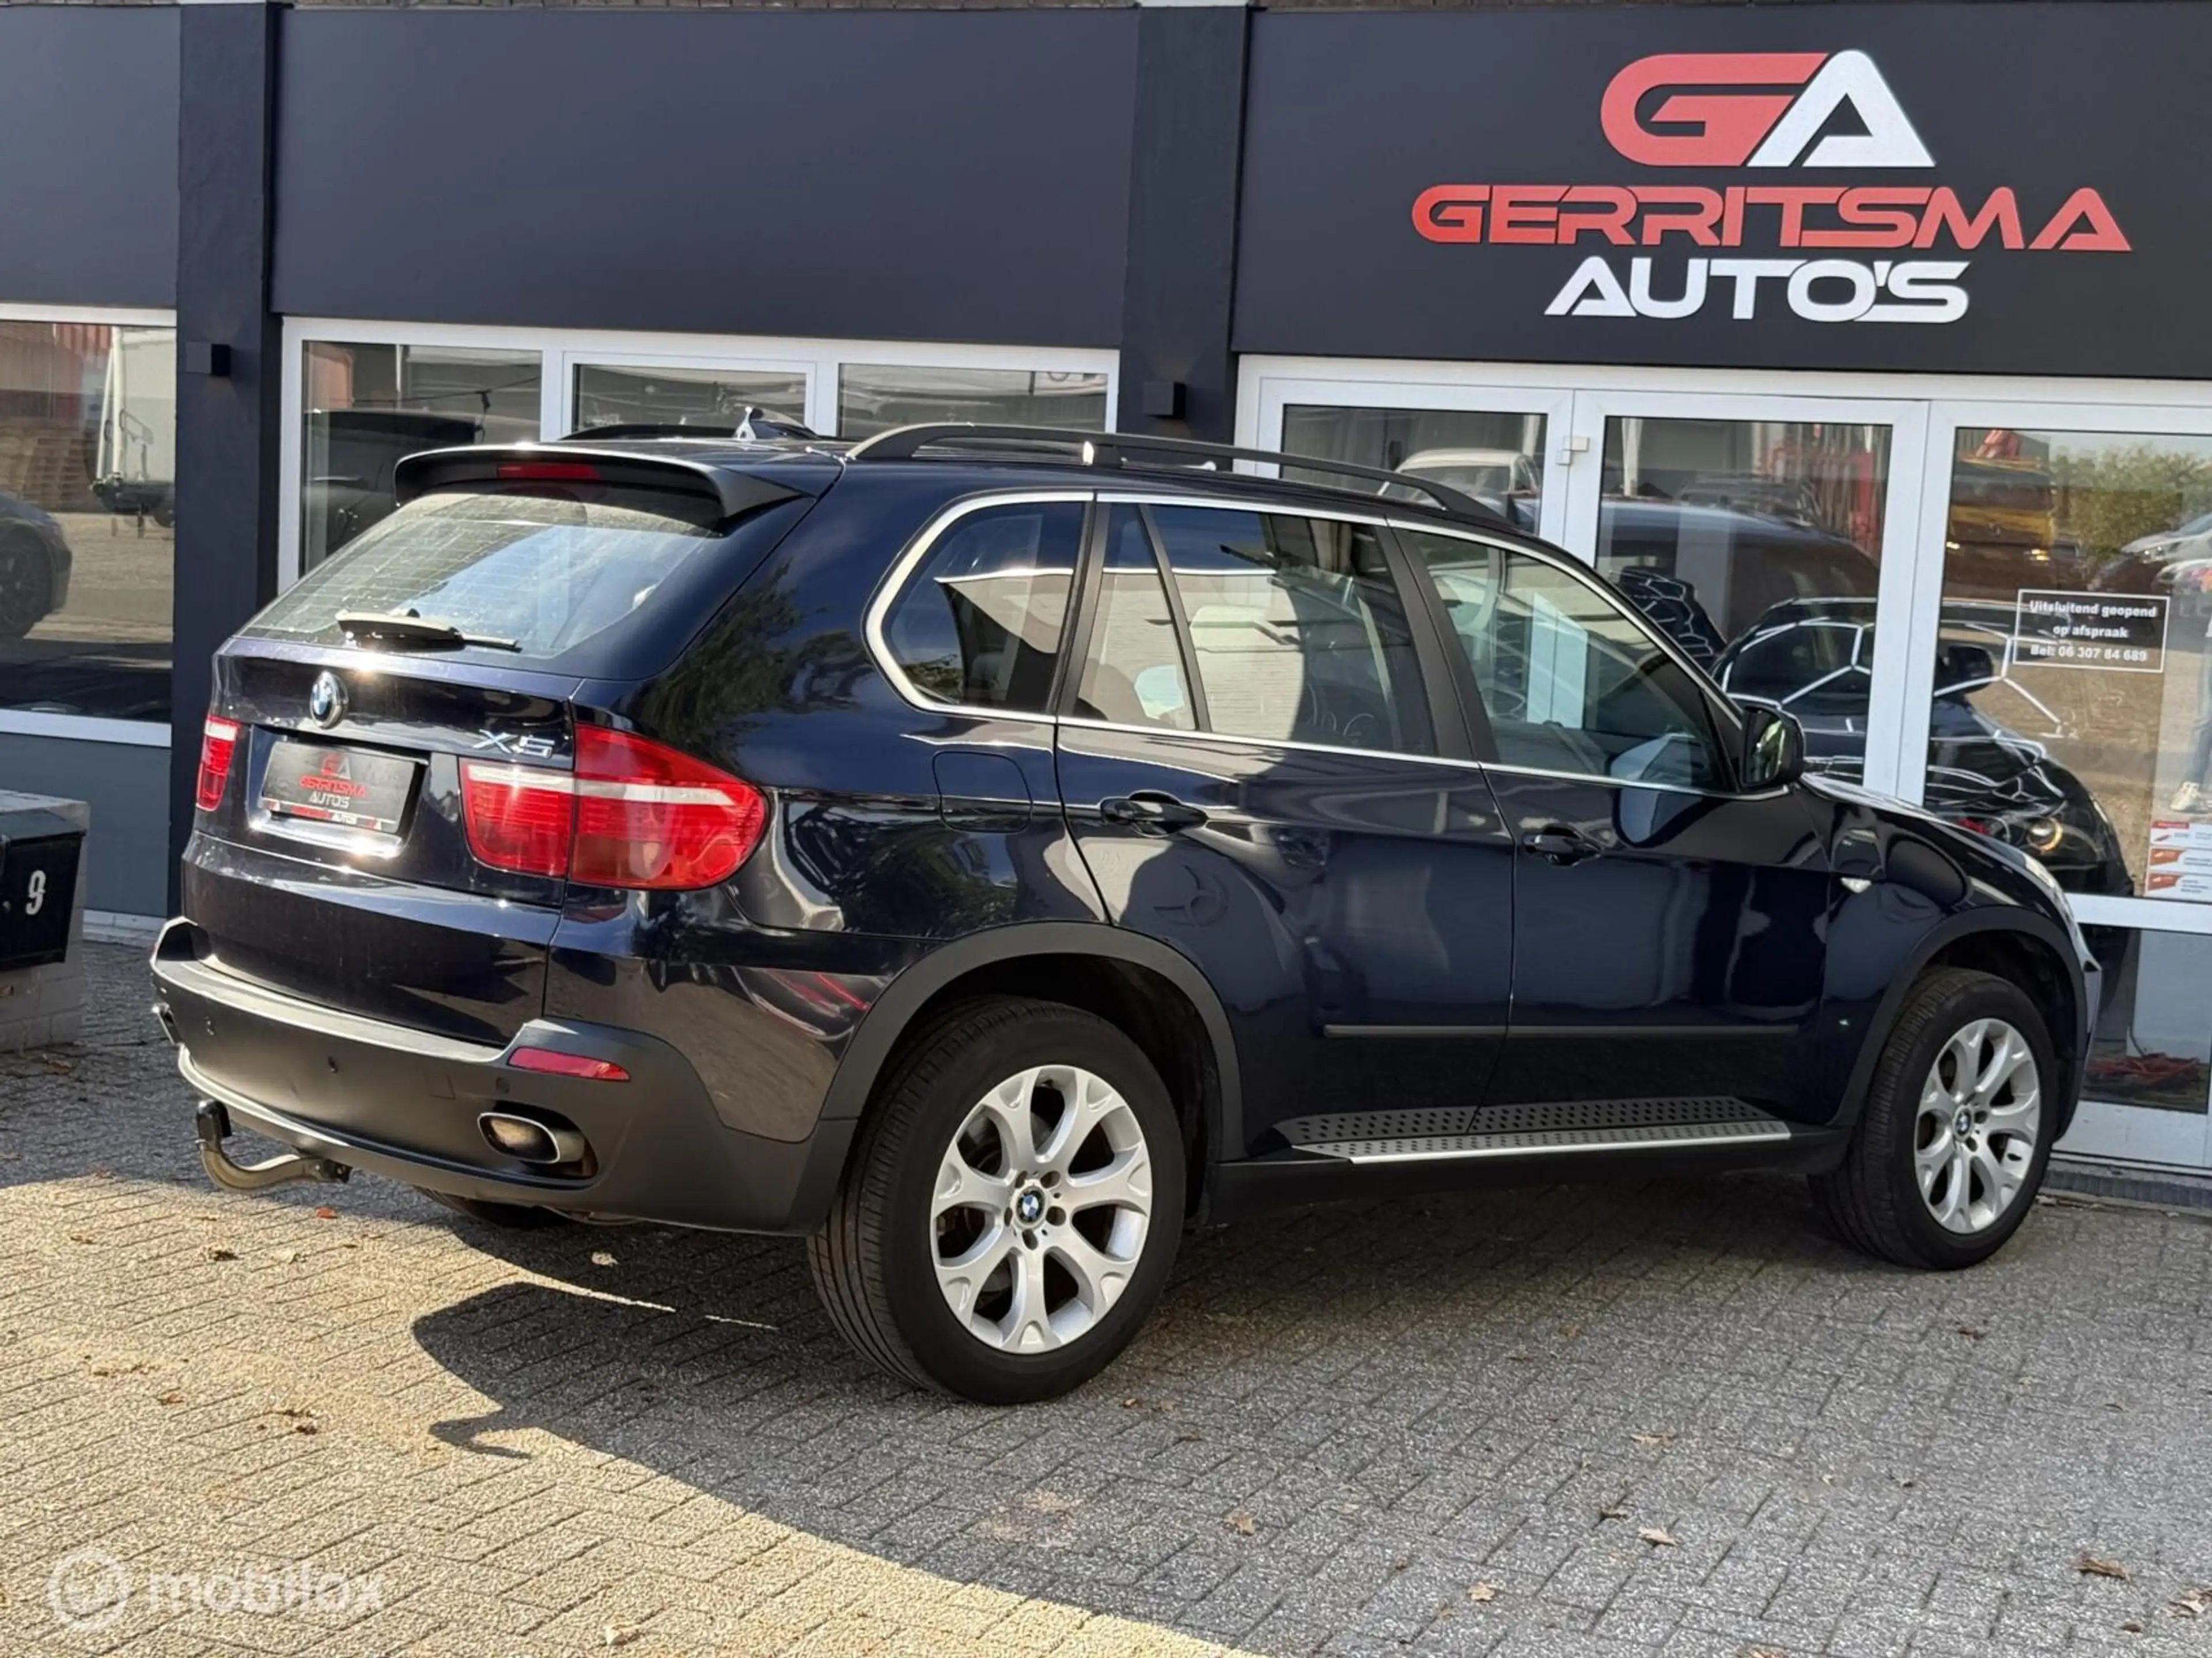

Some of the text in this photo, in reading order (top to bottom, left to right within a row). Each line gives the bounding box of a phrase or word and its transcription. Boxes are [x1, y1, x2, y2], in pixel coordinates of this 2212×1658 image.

[1601, 48, 1936, 168] GA
[1412, 184, 2133, 252] GERRITSMA
[1543, 255, 1969, 323] AUTO'S
[2029, 600, 2157, 619] Uitsluitend geopend
[2052, 624, 2129, 639] op afspraak
[2058, 646, 2074, 657] 06
[2077, 647, 2101, 659] 307
[472, 729, 555, 759] X5
[25, 870, 46, 915] 9
